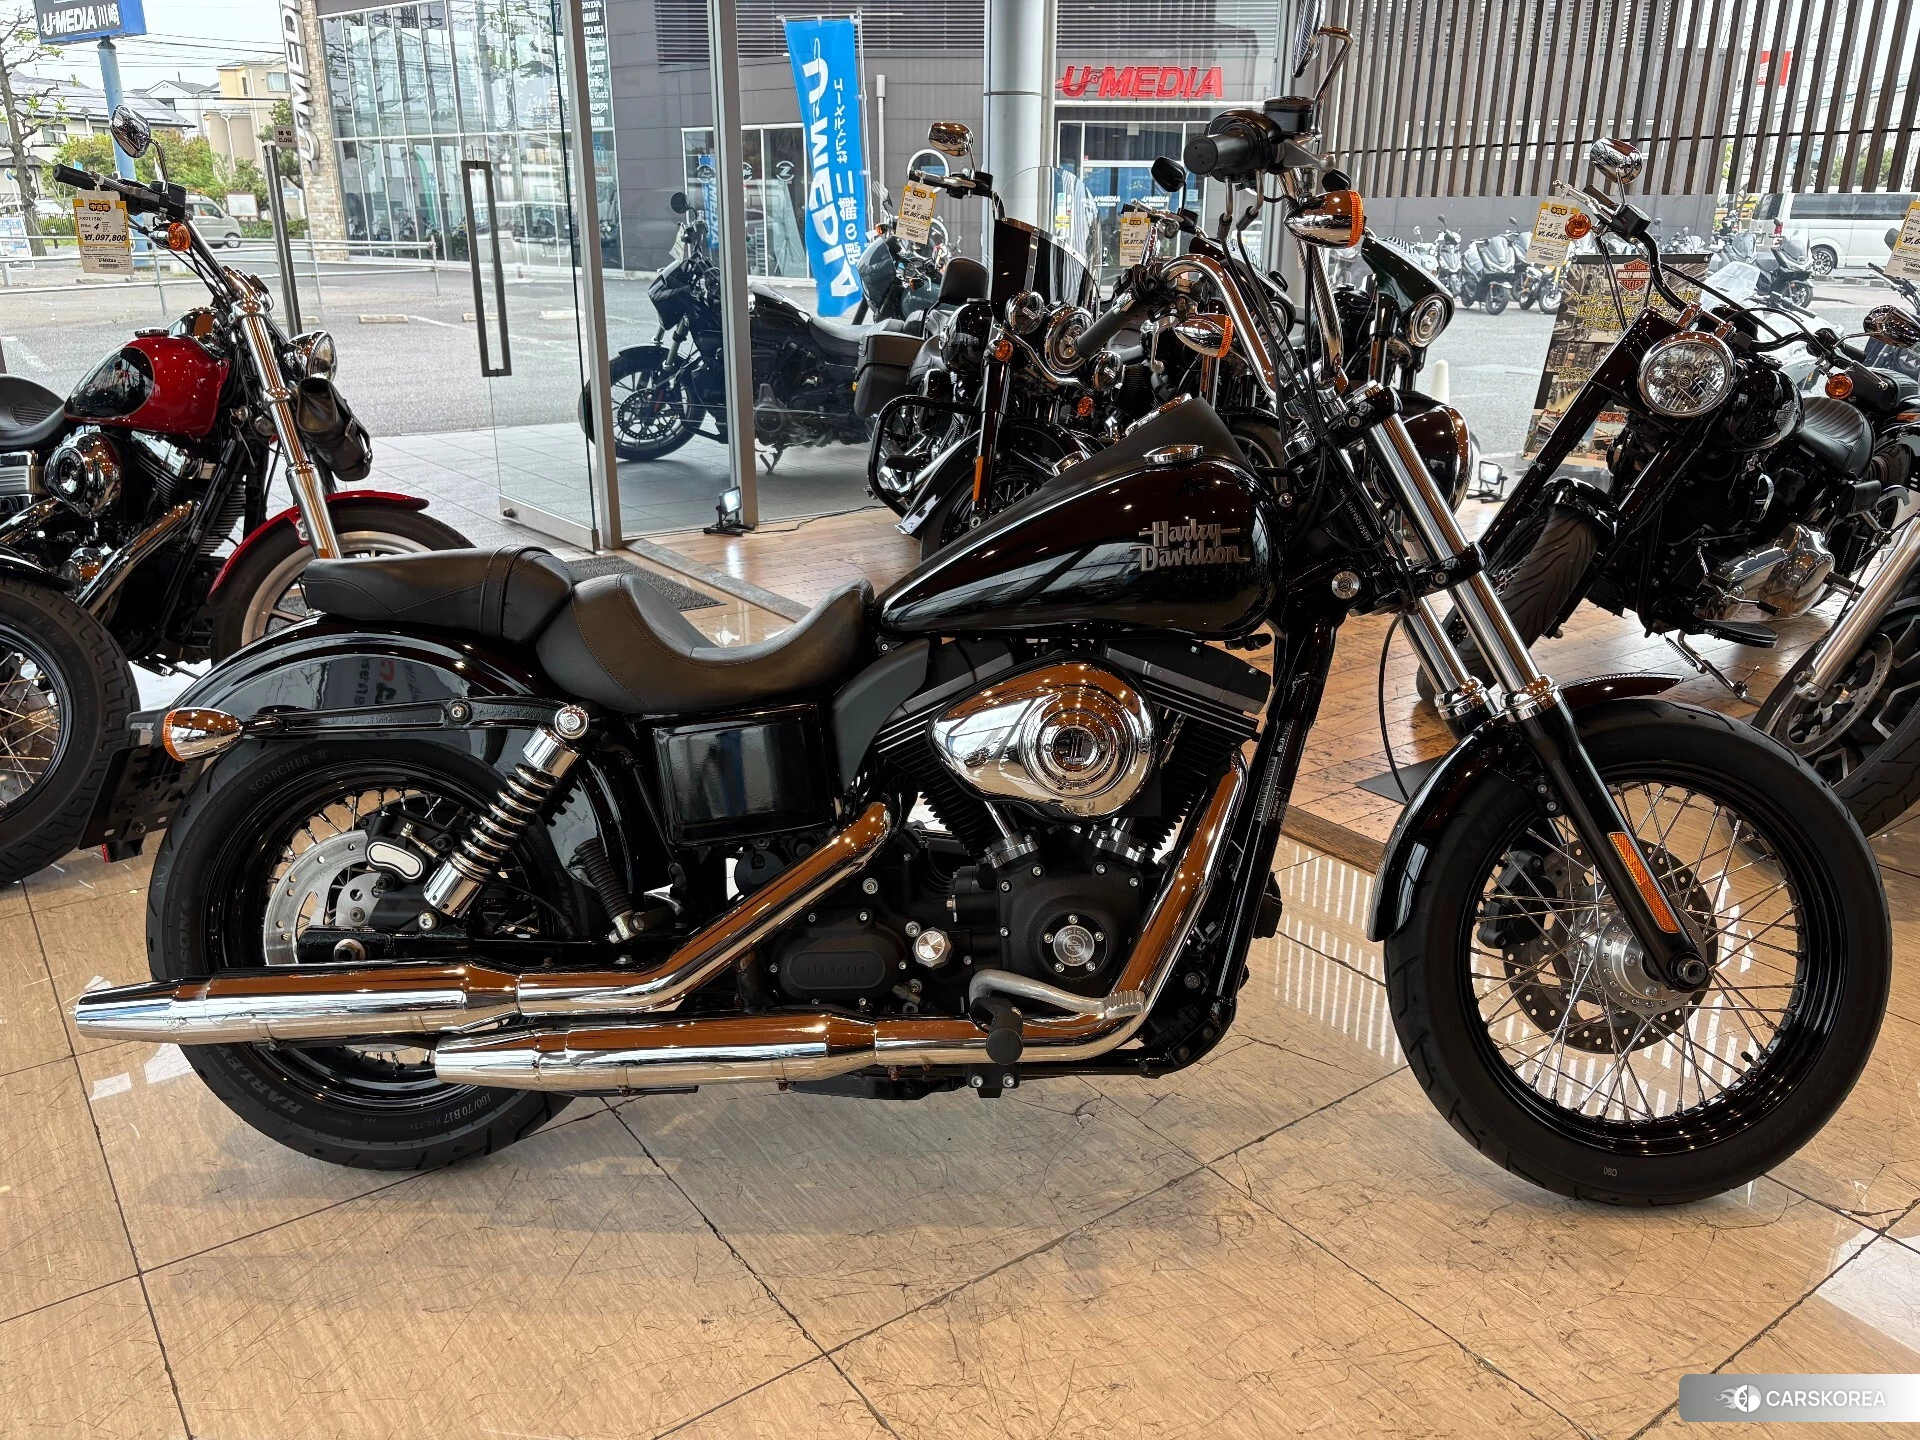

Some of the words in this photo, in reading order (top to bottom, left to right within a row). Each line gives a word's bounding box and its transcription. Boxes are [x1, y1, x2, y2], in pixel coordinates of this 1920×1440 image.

[1056, 65, 1224, 98] U-MEDIA
[1138, 518, 1241, 547] Harley
[1129, 540, 1251, 572] Davidson
[249, 754, 310, 794] SCORCHER
[216, 1045, 304, 1114] HARLEY
